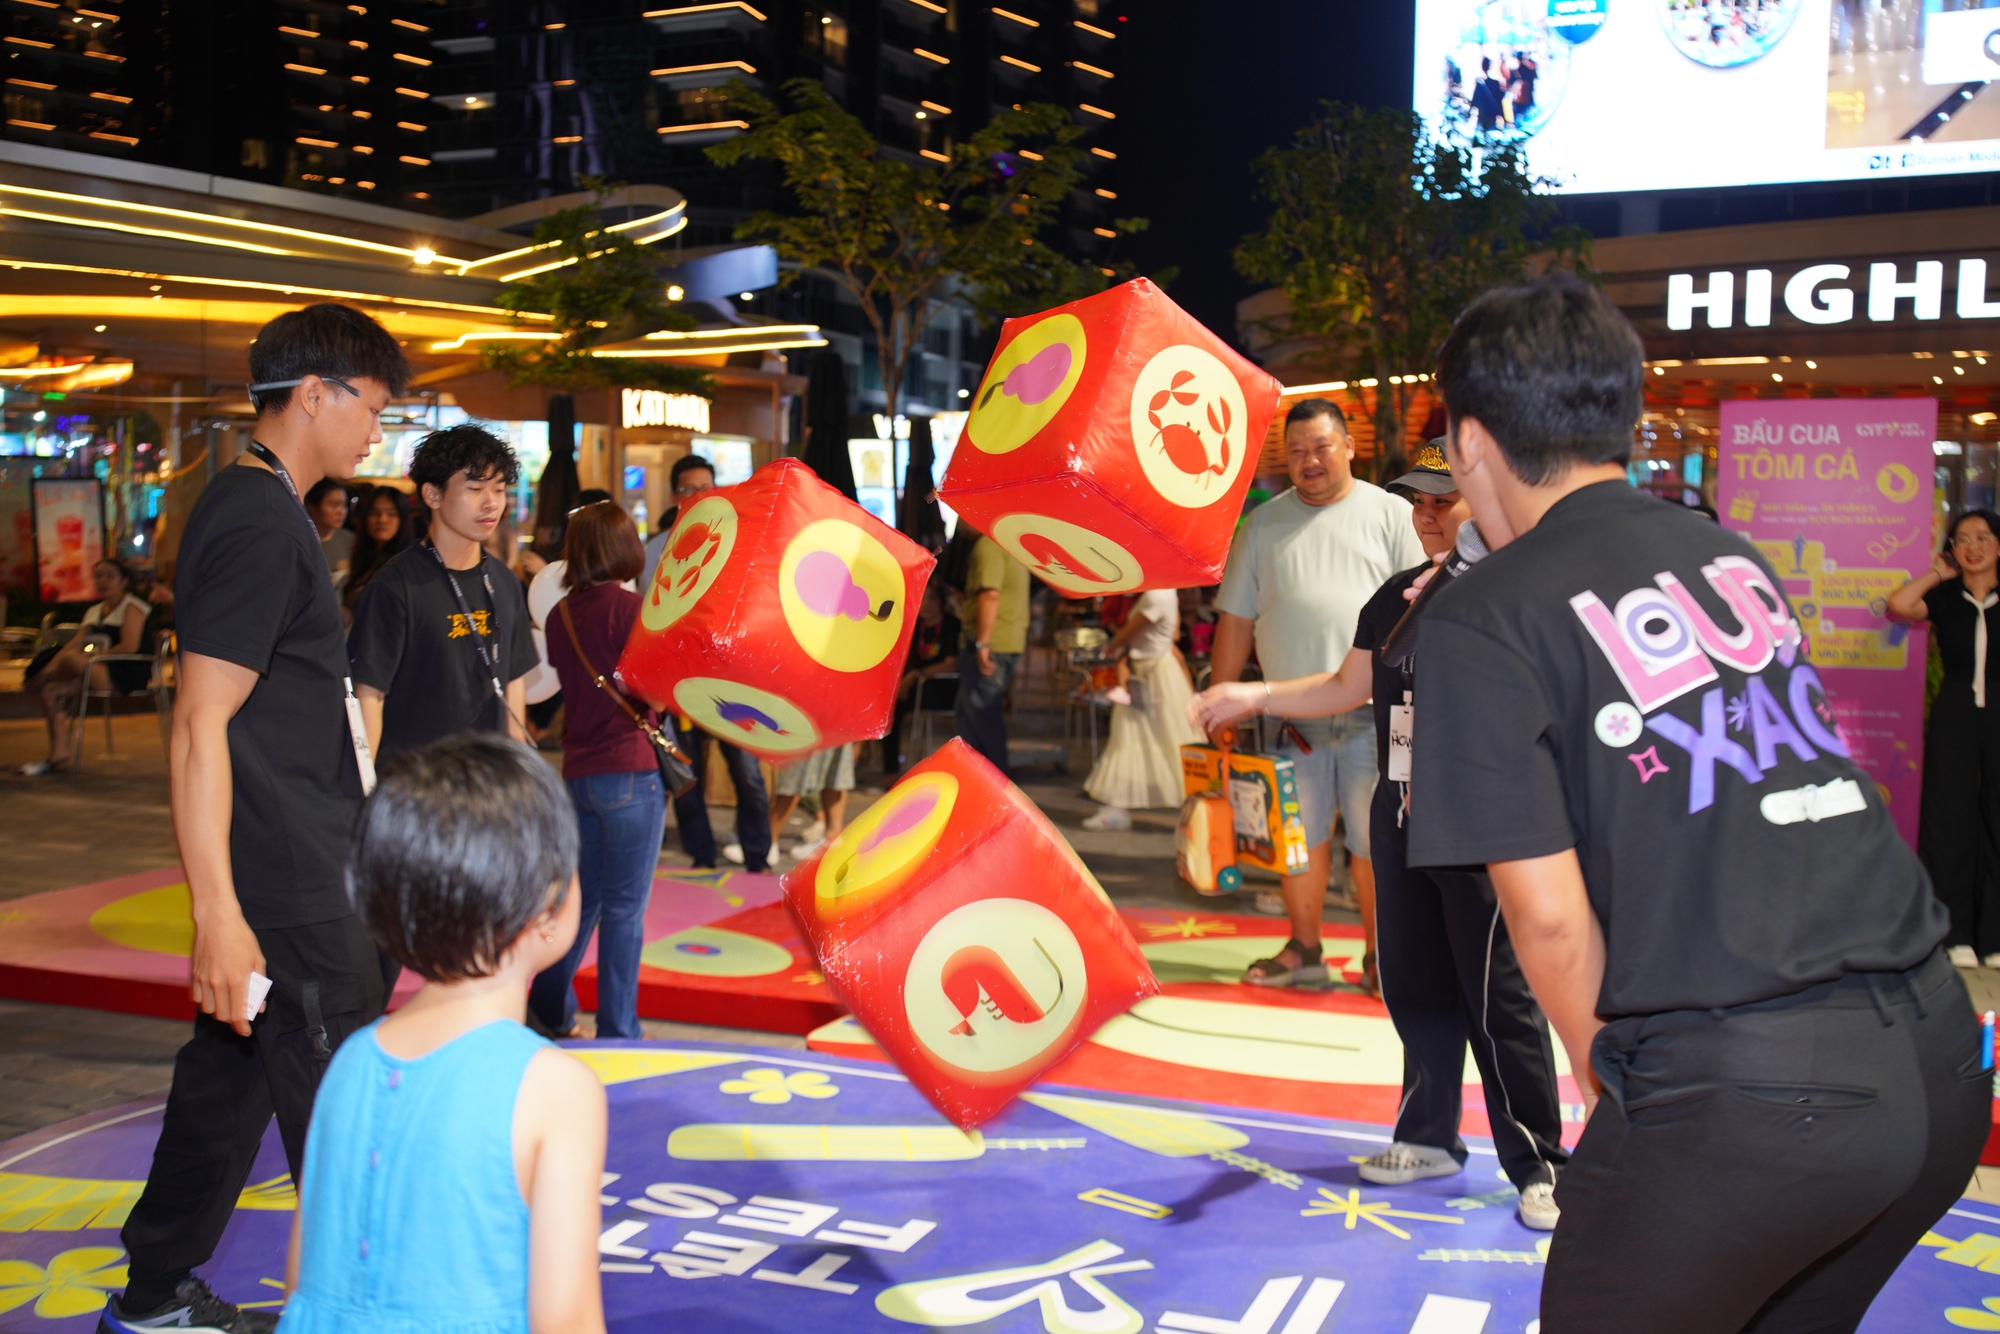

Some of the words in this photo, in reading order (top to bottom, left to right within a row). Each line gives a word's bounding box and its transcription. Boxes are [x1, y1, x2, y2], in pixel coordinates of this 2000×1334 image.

[1732, 418, 1784, 445] BẦU
[1789, 423, 1841, 445] CUA
[1732, 447, 1806, 480] TÔM
[598, 1171, 938, 1253] FES
